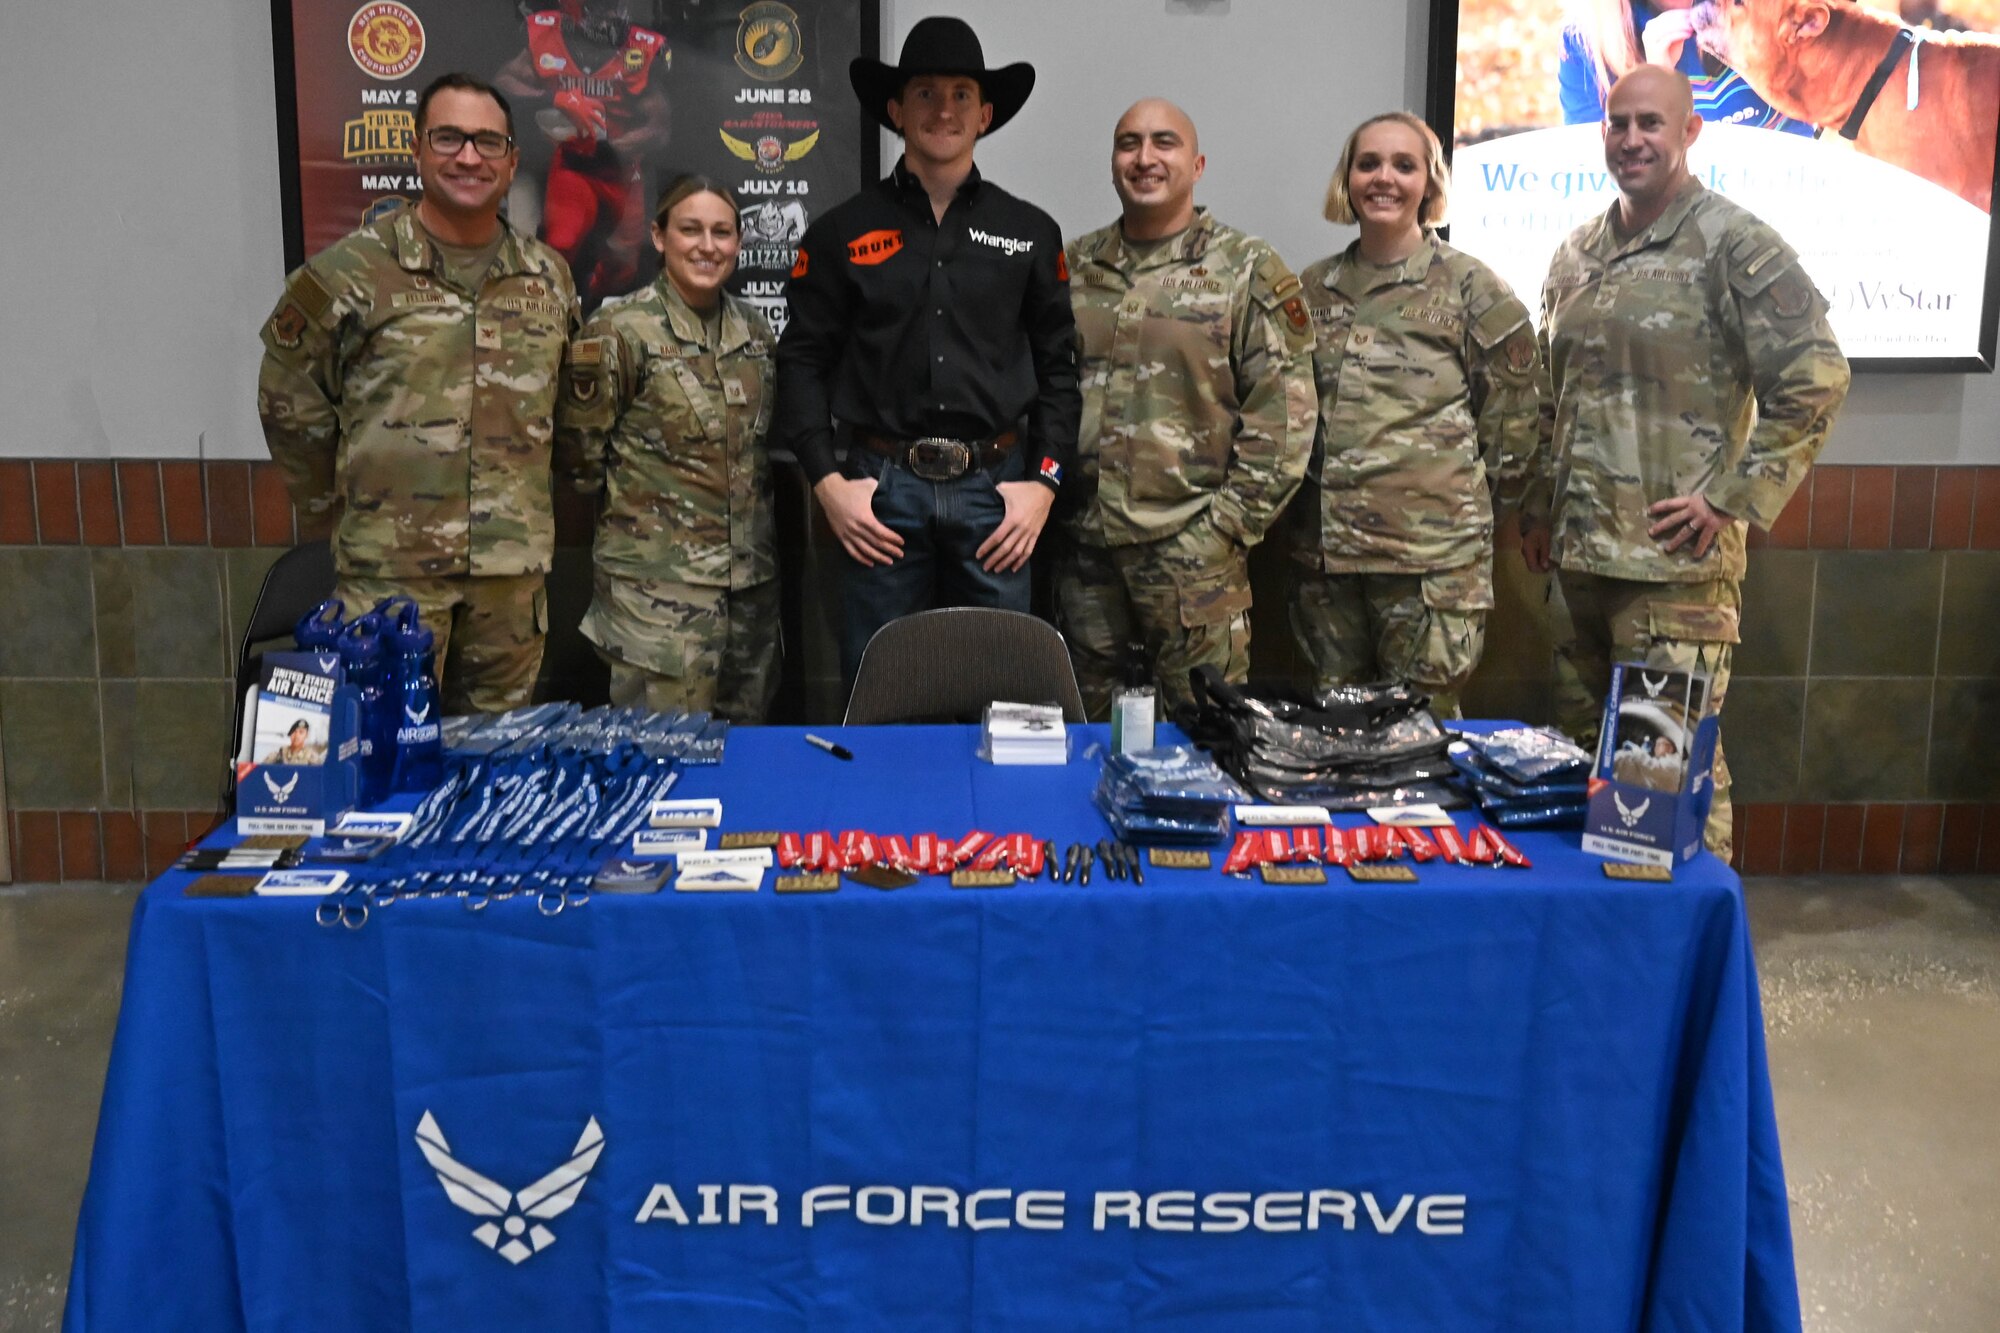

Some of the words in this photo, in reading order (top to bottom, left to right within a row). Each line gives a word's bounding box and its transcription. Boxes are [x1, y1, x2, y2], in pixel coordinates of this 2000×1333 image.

[379, 5, 414, 28] MEXICO
[361, 89, 402, 104] MAY
[405, 90, 418, 105] 2
[734, 88, 785, 104] JUNE
[787, 88, 812, 104] 28
[367, 114, 410, 127] TULSA
[347, 123, 414, 153] OILER
[361, 175, 402, 190] MAY
[737, 180, 783, 195] JULY
[786, 180, 809, 195] 18
[1479, 162, 1540, 193] We
[849, 230, 904, 258] BRUNT
[968, 226, 1034, 256] Wrangler
[738, 249, 799, 270] BLIZZAR
[741, 281, 785, 295] JULY
[273, 665, 304, 682] UNITED
[303, 673, 335, 690] STATES
[266, 677, 291, 696] AIR
[291, 681, 334, 704] FORCE
[397, 727, 418, 743] AIR
[268, 805, 281, 814] AIR
[282, 806, 308, 815] FORCE
[635, 1183, 779, 1226] AIR
[802, 1185, 1065, 1231] FORCE
[1093, 1189, 1467, 1236] RESERVE
